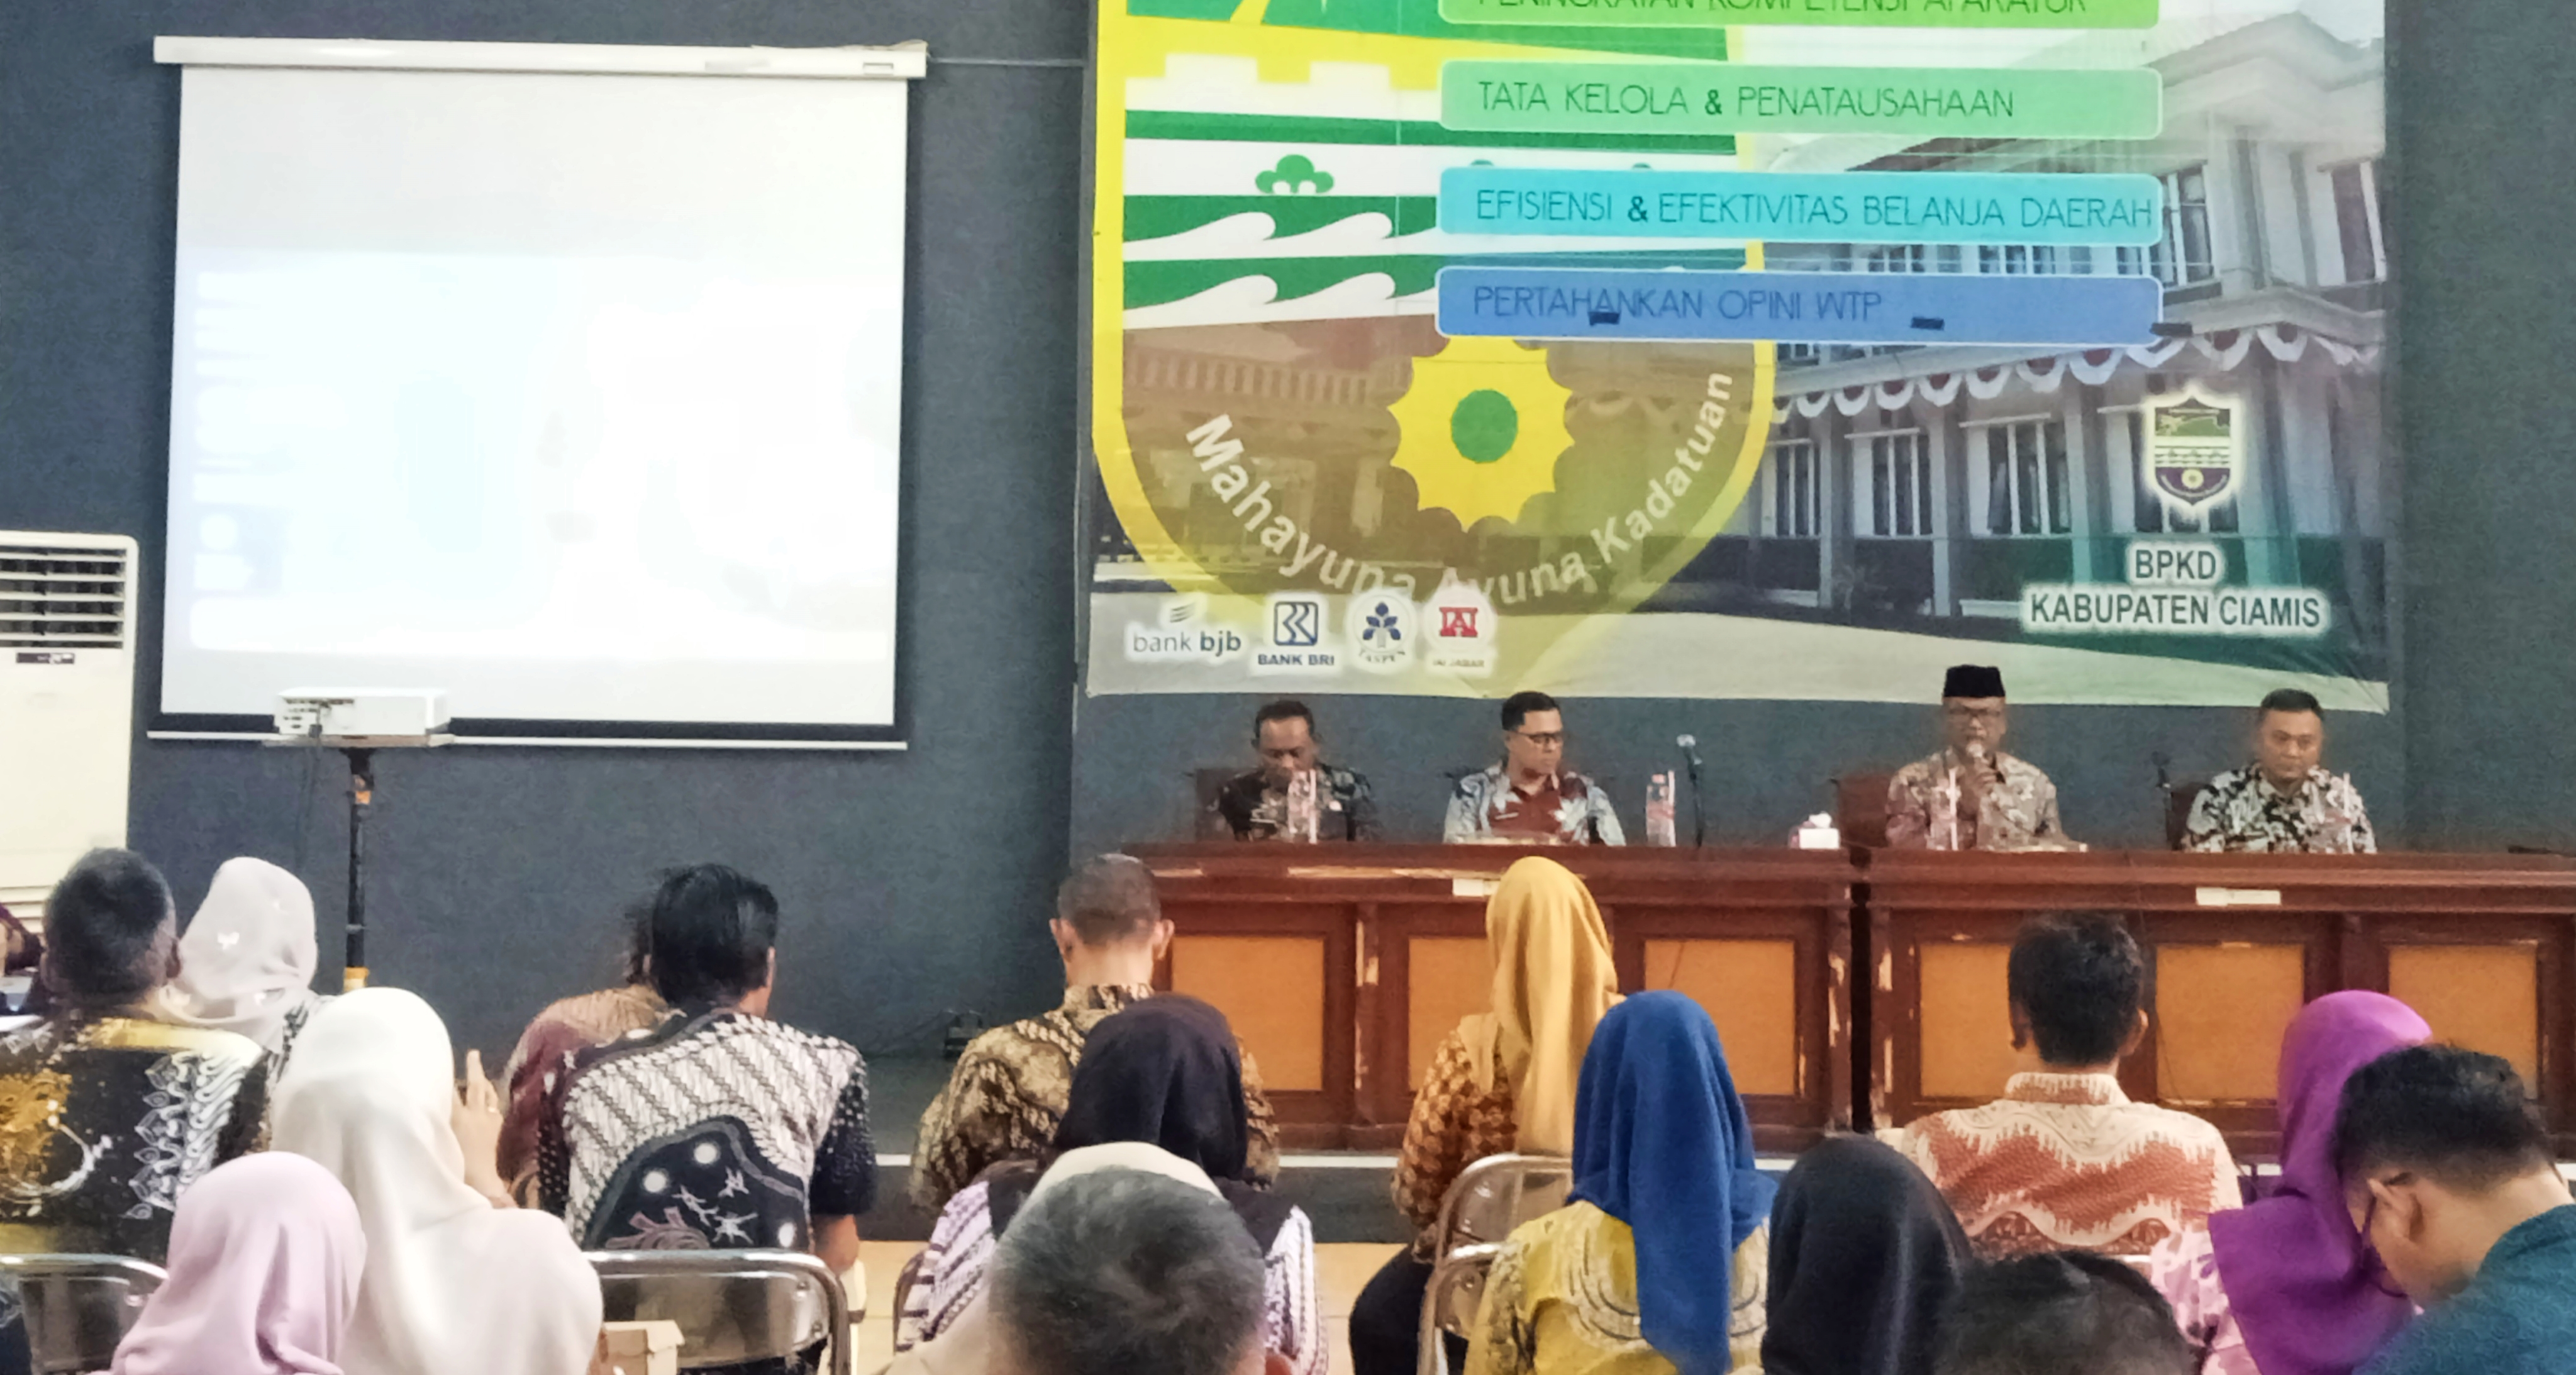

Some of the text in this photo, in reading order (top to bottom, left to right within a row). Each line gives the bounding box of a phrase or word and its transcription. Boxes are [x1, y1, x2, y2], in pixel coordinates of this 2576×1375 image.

[1479, 81, 2012, 118] TATA KELOLA & PENATAUSAHAAN
[1477, 189, 2152, 228] EFISIENSI & EFEKTIVITAS BELANJA DAERAH
[1474, 285, 1882, 322] PERTAHANKAN OPINI WTP
[1590, 372, 1733, 564] Kadatuan
[2134, 548, 2217, 580] BPKD
[2030, 593, 2321, 628] KABUPATEN CIAMIS
[1133, 631, 1241, 657] bank bjb
[1258, 654, 1335, 666] BANK BRI
